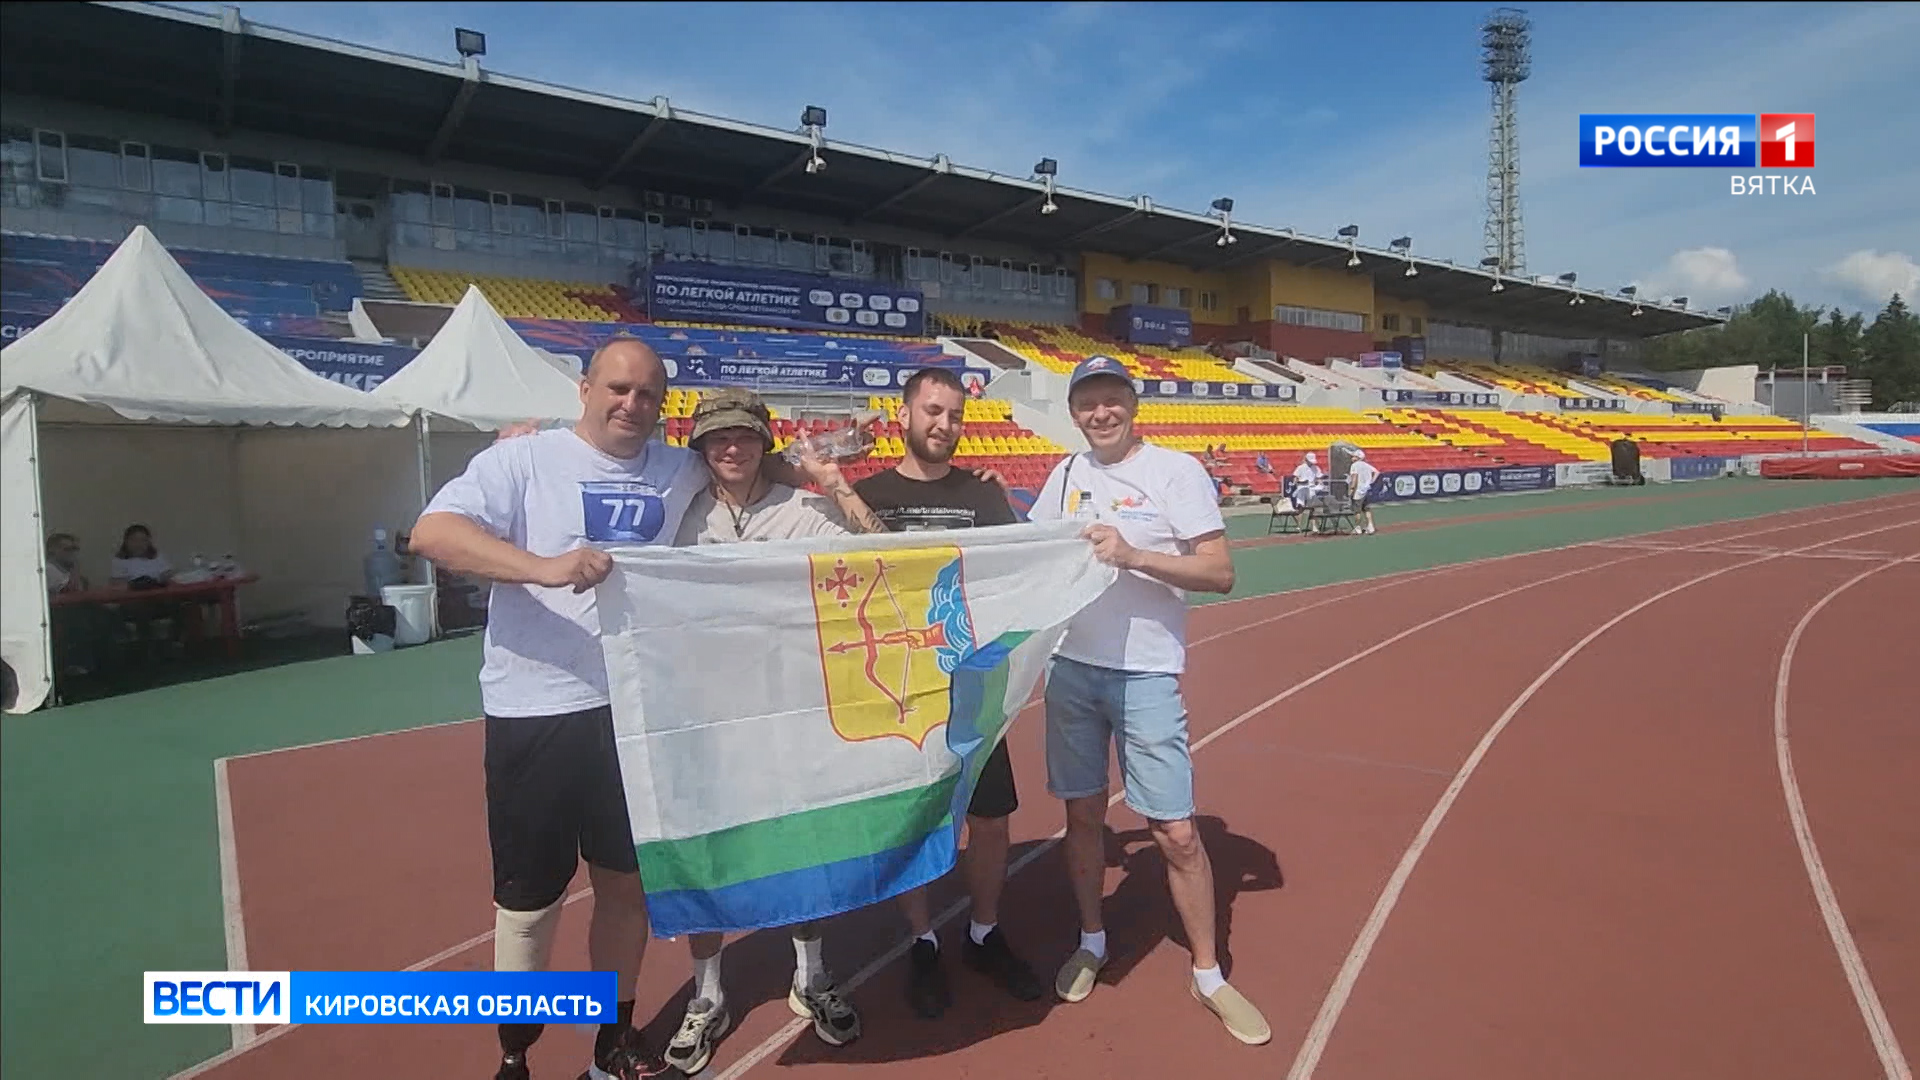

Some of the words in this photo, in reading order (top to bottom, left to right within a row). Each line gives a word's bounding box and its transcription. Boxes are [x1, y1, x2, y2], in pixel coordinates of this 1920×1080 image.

[655, 283, 678, 296] ПО
[679, 286, 735, 300] ЛЕГКОЙ
[735, 291, 801, 306] АТЛЕТИКЕ
[720, 365, 738, 374] ПО
[779, 367, 828, 378] АТЛЕТИКЕ
[600, 498, 646, 528] 77
